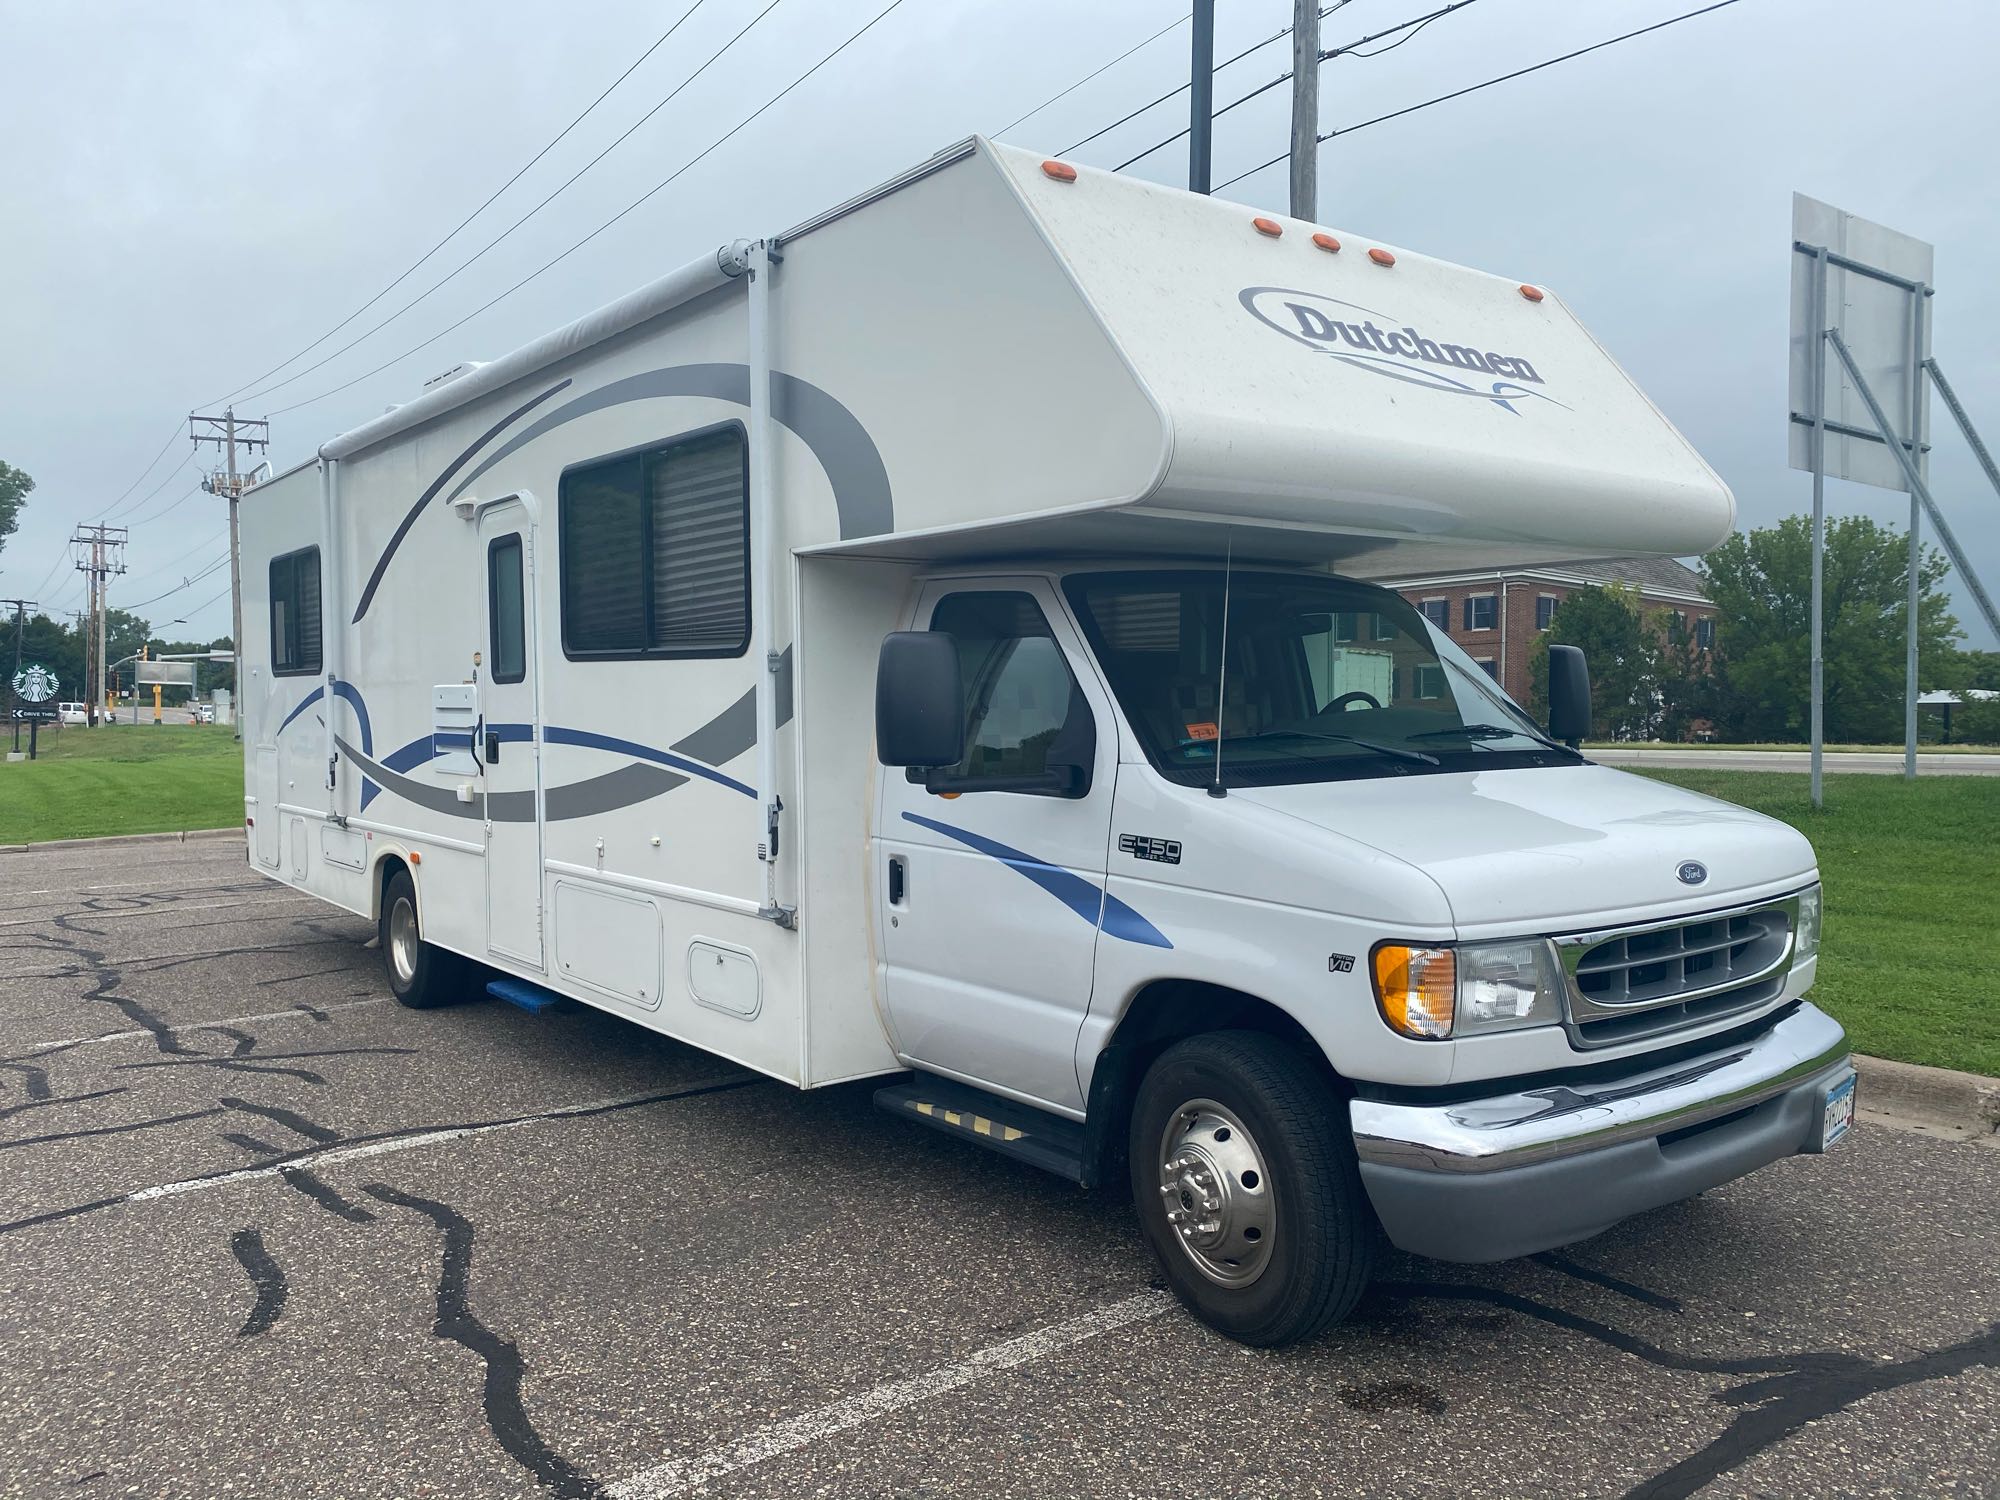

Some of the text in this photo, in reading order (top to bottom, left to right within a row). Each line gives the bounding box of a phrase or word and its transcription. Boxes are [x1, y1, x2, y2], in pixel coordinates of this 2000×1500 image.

[1284, 302, 1546, 384] Dutchmen
[1684, 866, 1701, 879] Ford
[1330, 957, 1352, 971] V10
